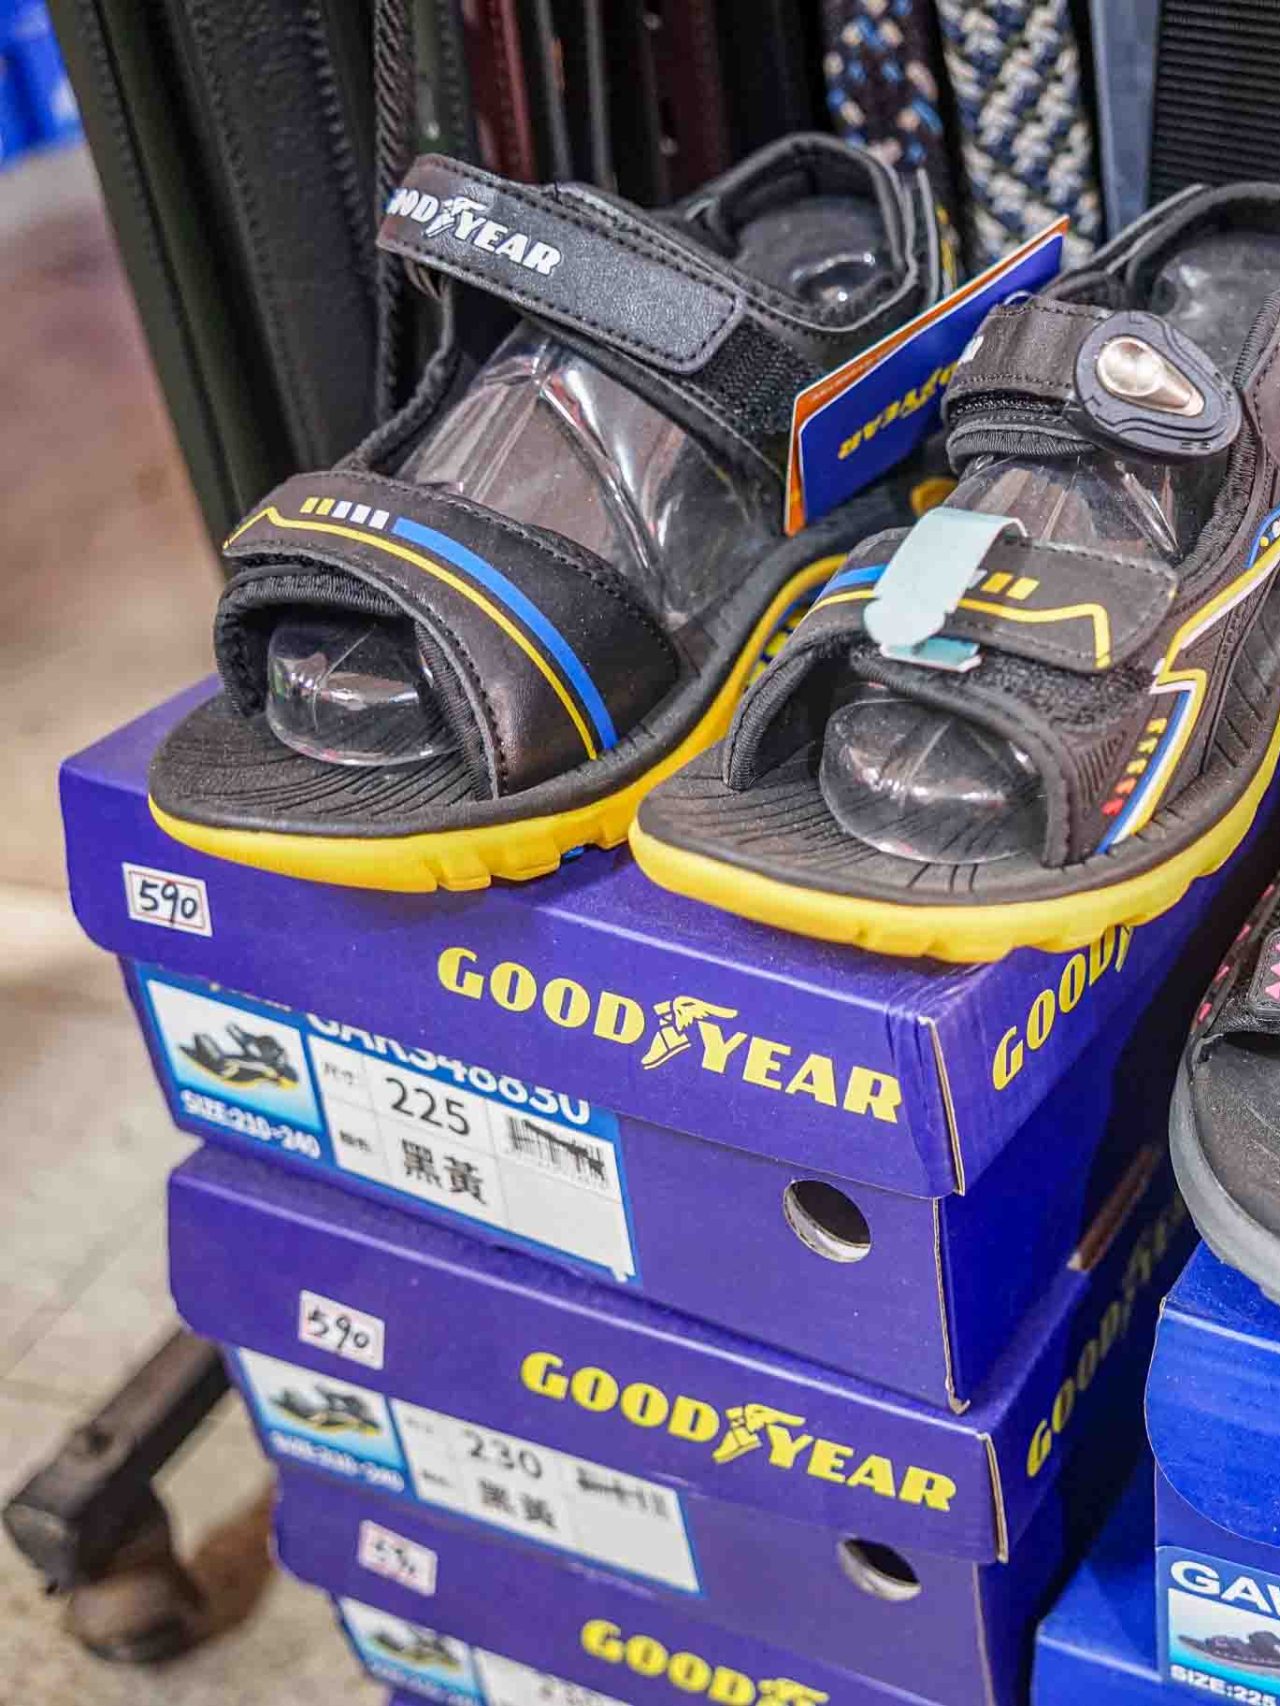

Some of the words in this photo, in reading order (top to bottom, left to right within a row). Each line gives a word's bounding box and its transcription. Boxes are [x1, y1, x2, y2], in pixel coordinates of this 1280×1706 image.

[139, 879, 198, 924] 590
[437, 946, 902, 1124] GOODYEAR
[385, 1076, 471, 1136] 225
[308, 1305, 371, 1351] 590
[520, 1350, 957, 1511] GOODYEAR
[1170, 1664, 1278, 1704] SIZE:225
